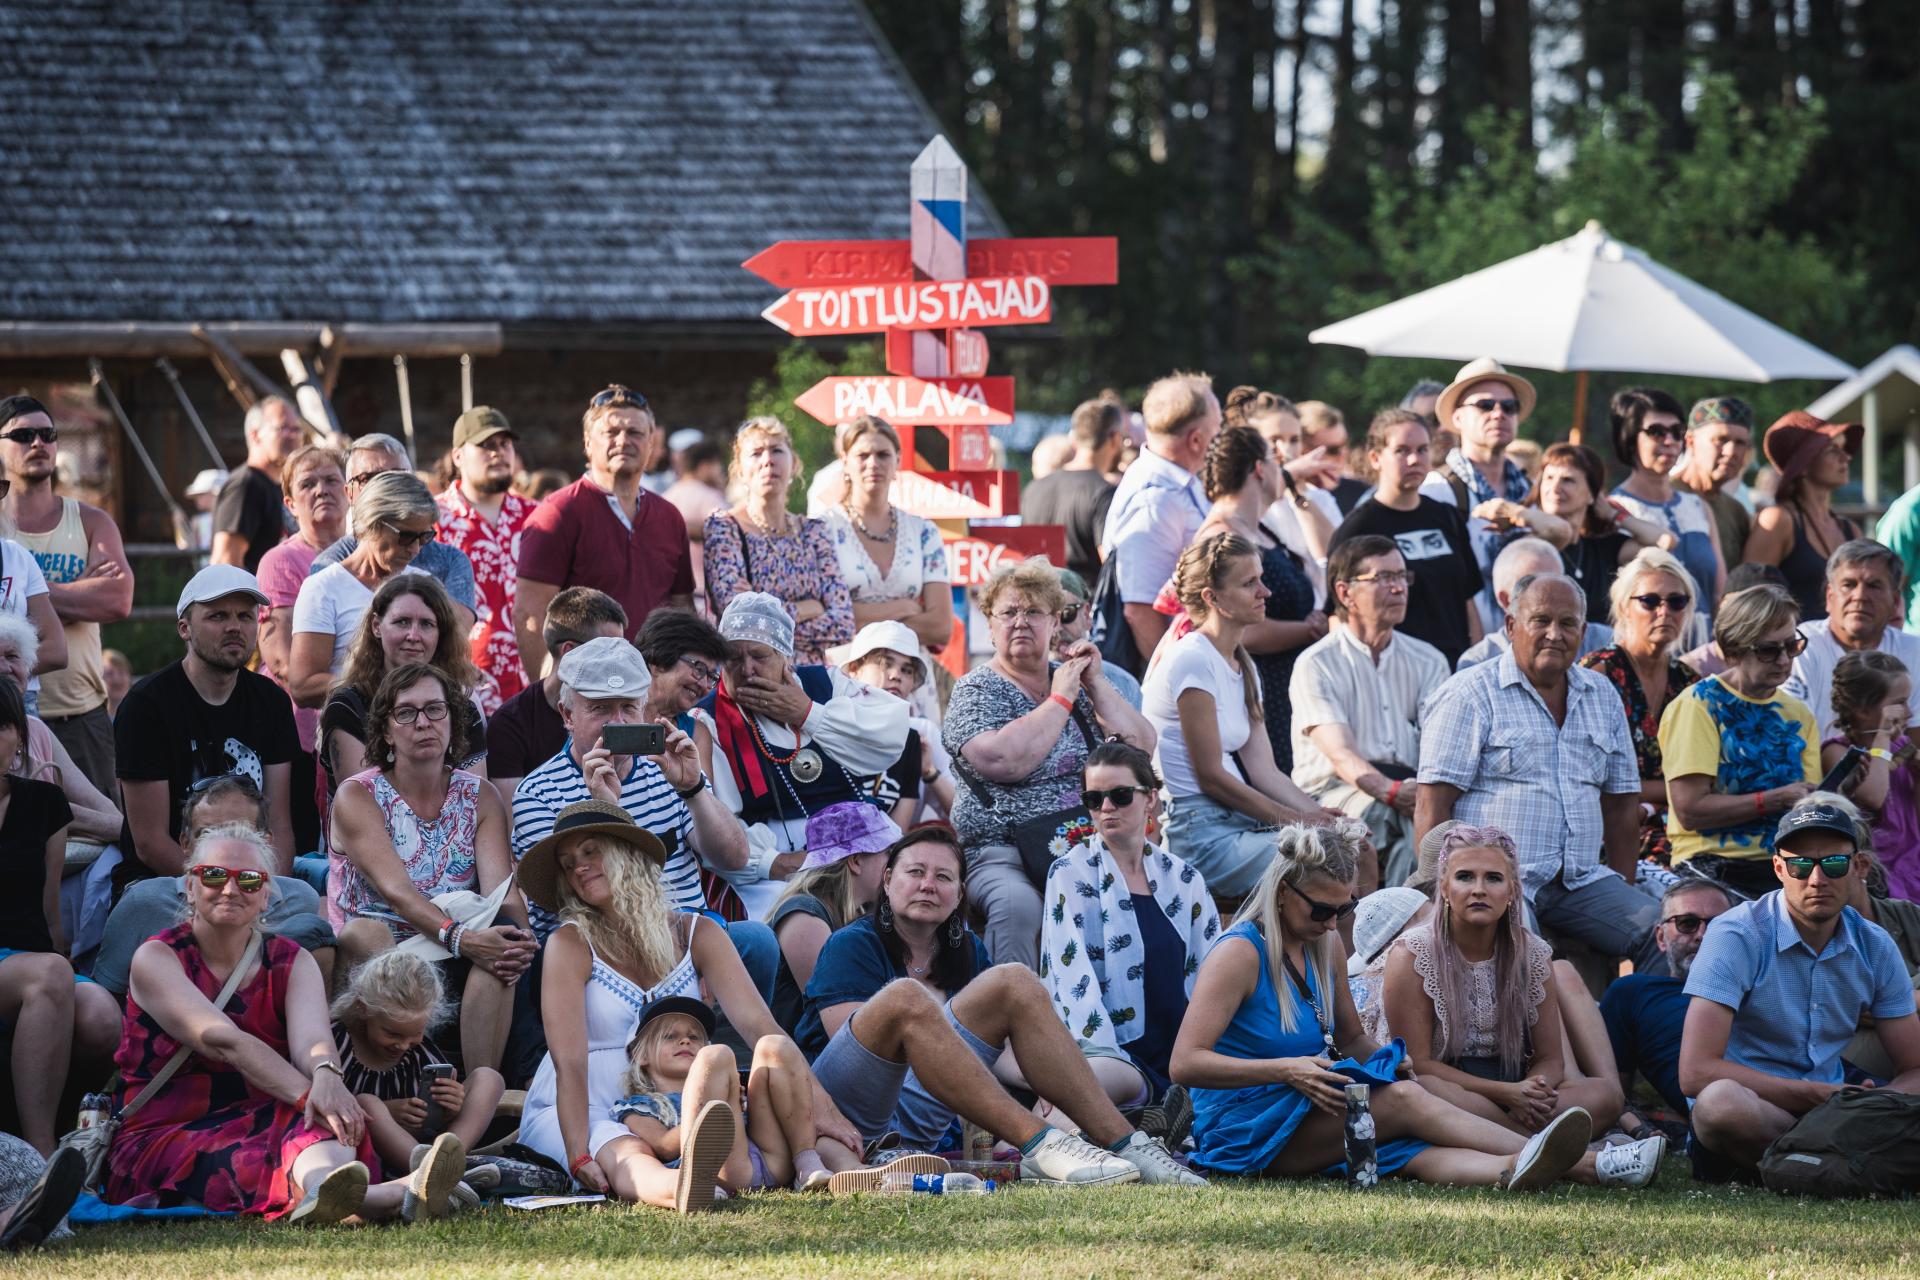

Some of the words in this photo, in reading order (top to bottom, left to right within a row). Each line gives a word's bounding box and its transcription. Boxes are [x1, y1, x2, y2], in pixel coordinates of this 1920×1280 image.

[805, 250, 914, 280] KIRMA
[797, 276, 1049, 328] TOITLUSTAJAD
[834, 378, 989, 417] PÄÄLAVA
[30, 550, 84, 576] NGELES
